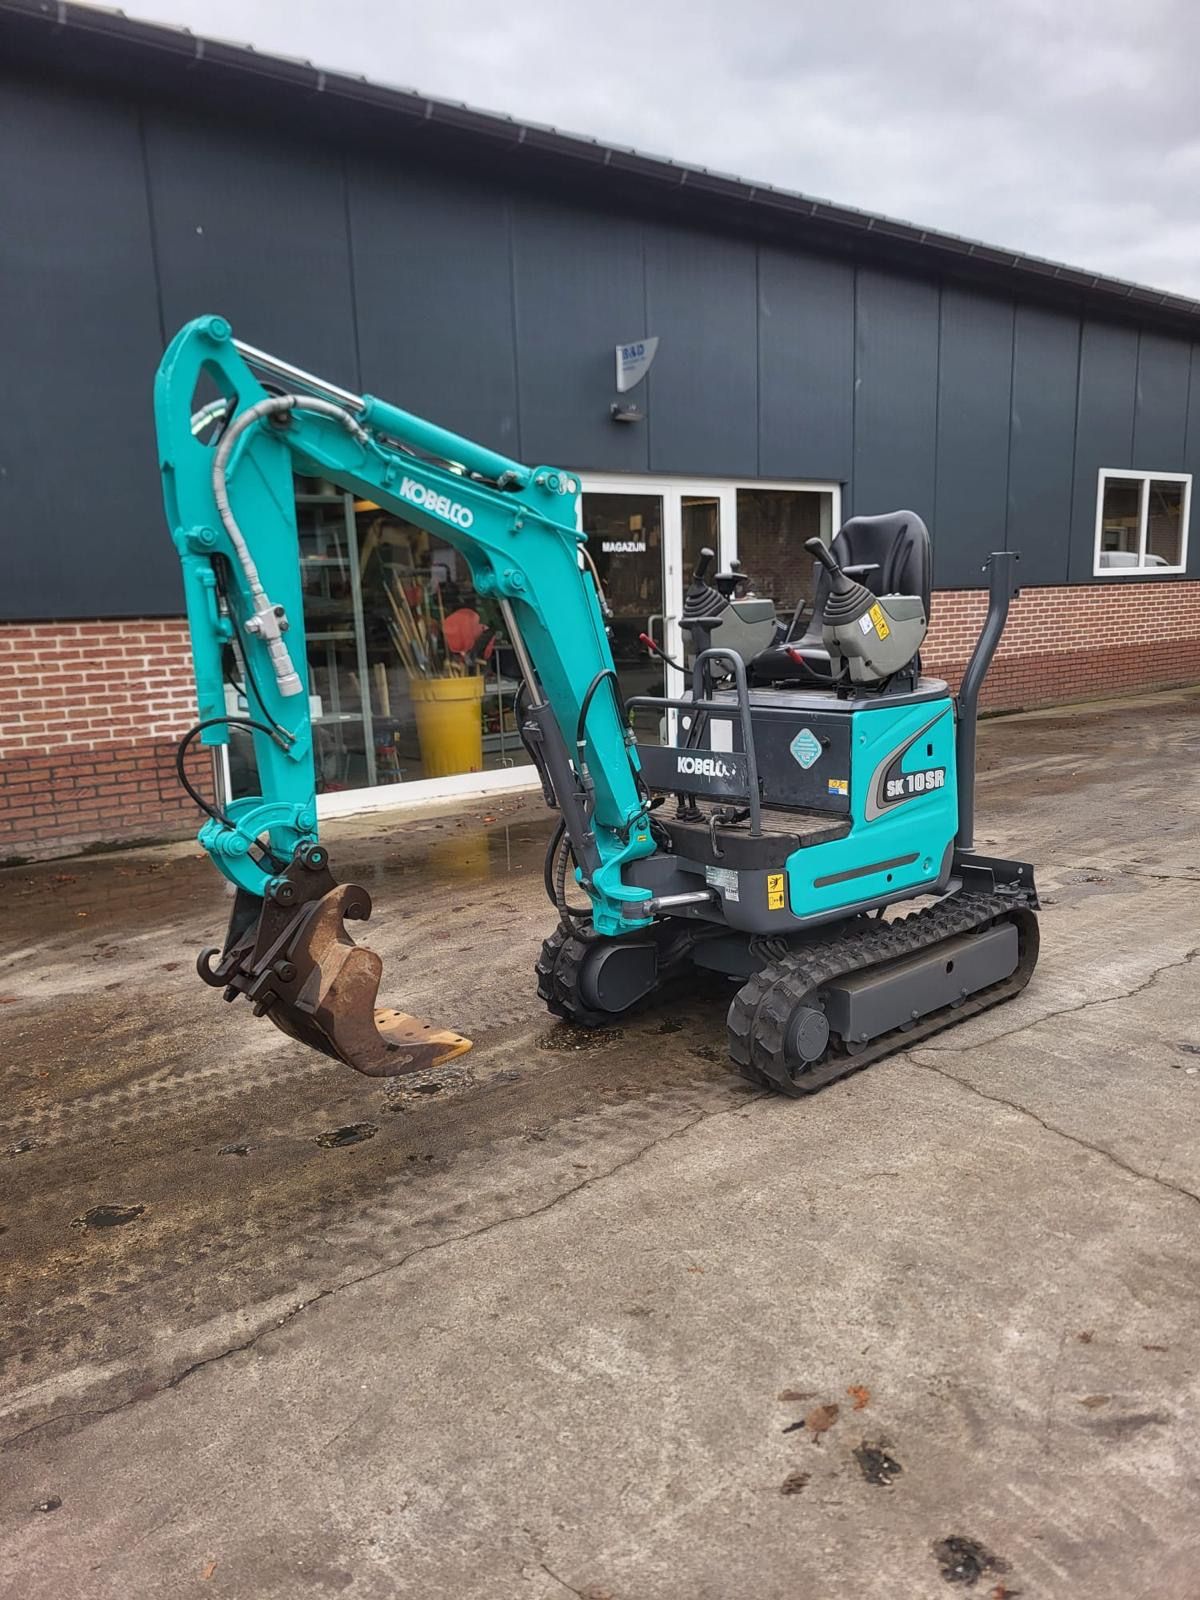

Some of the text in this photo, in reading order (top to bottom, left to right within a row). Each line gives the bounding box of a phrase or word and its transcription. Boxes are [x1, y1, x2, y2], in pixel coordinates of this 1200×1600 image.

[400, 477, 474, 528] KOBELCO
[602, 541, 646, 553] MAGAZIJN
[887, 769, 945, 797] SK 10SR
